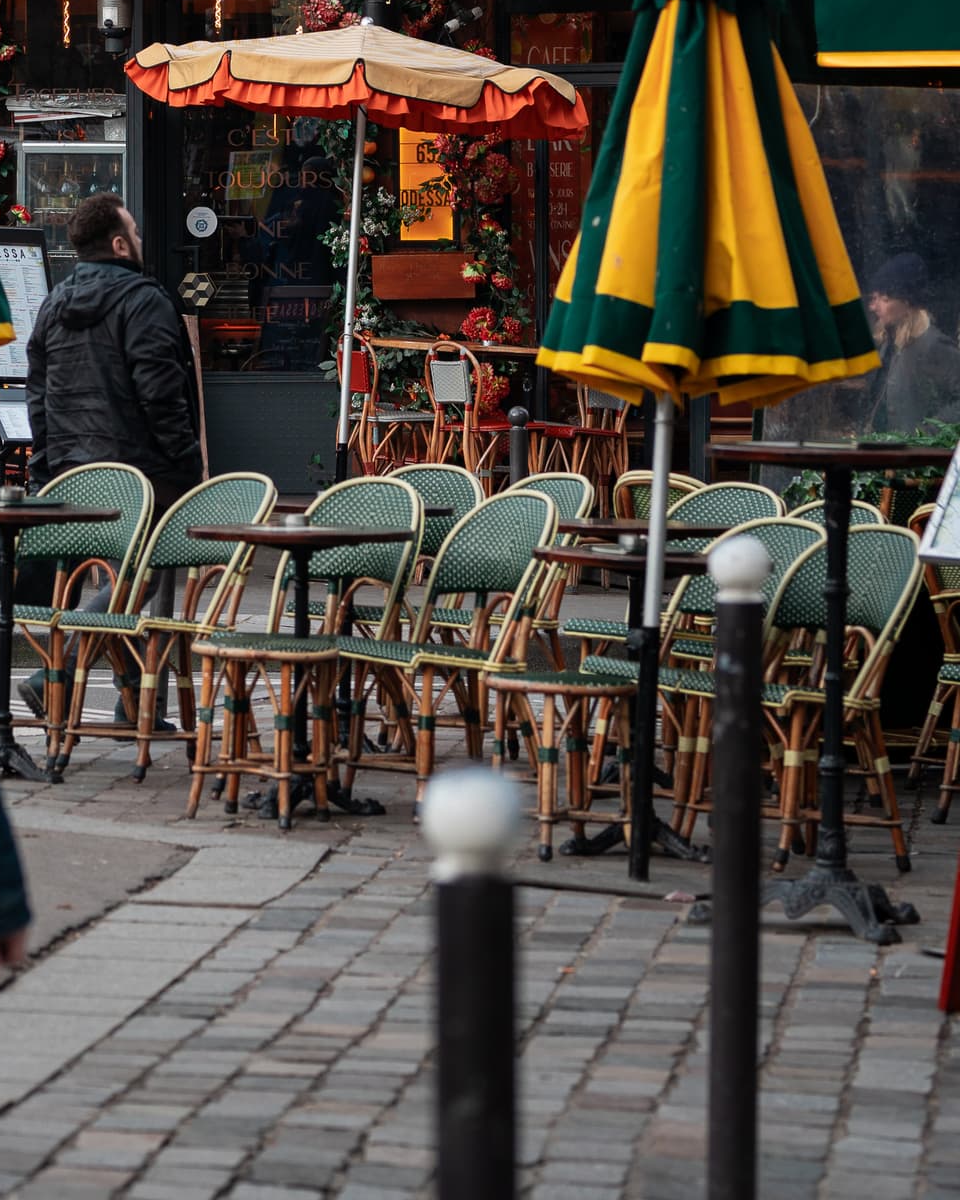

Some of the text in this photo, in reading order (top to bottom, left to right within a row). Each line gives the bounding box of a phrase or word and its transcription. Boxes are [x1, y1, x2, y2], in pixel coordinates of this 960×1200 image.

[226, 128, 292, 147] C'EST
[416, 143, 436, 163] 65
[208, 170, 333, 189] TOUJOURS
[401, 189, 451, 207] ODESSA
[244, 220, 290, 239] UNE
